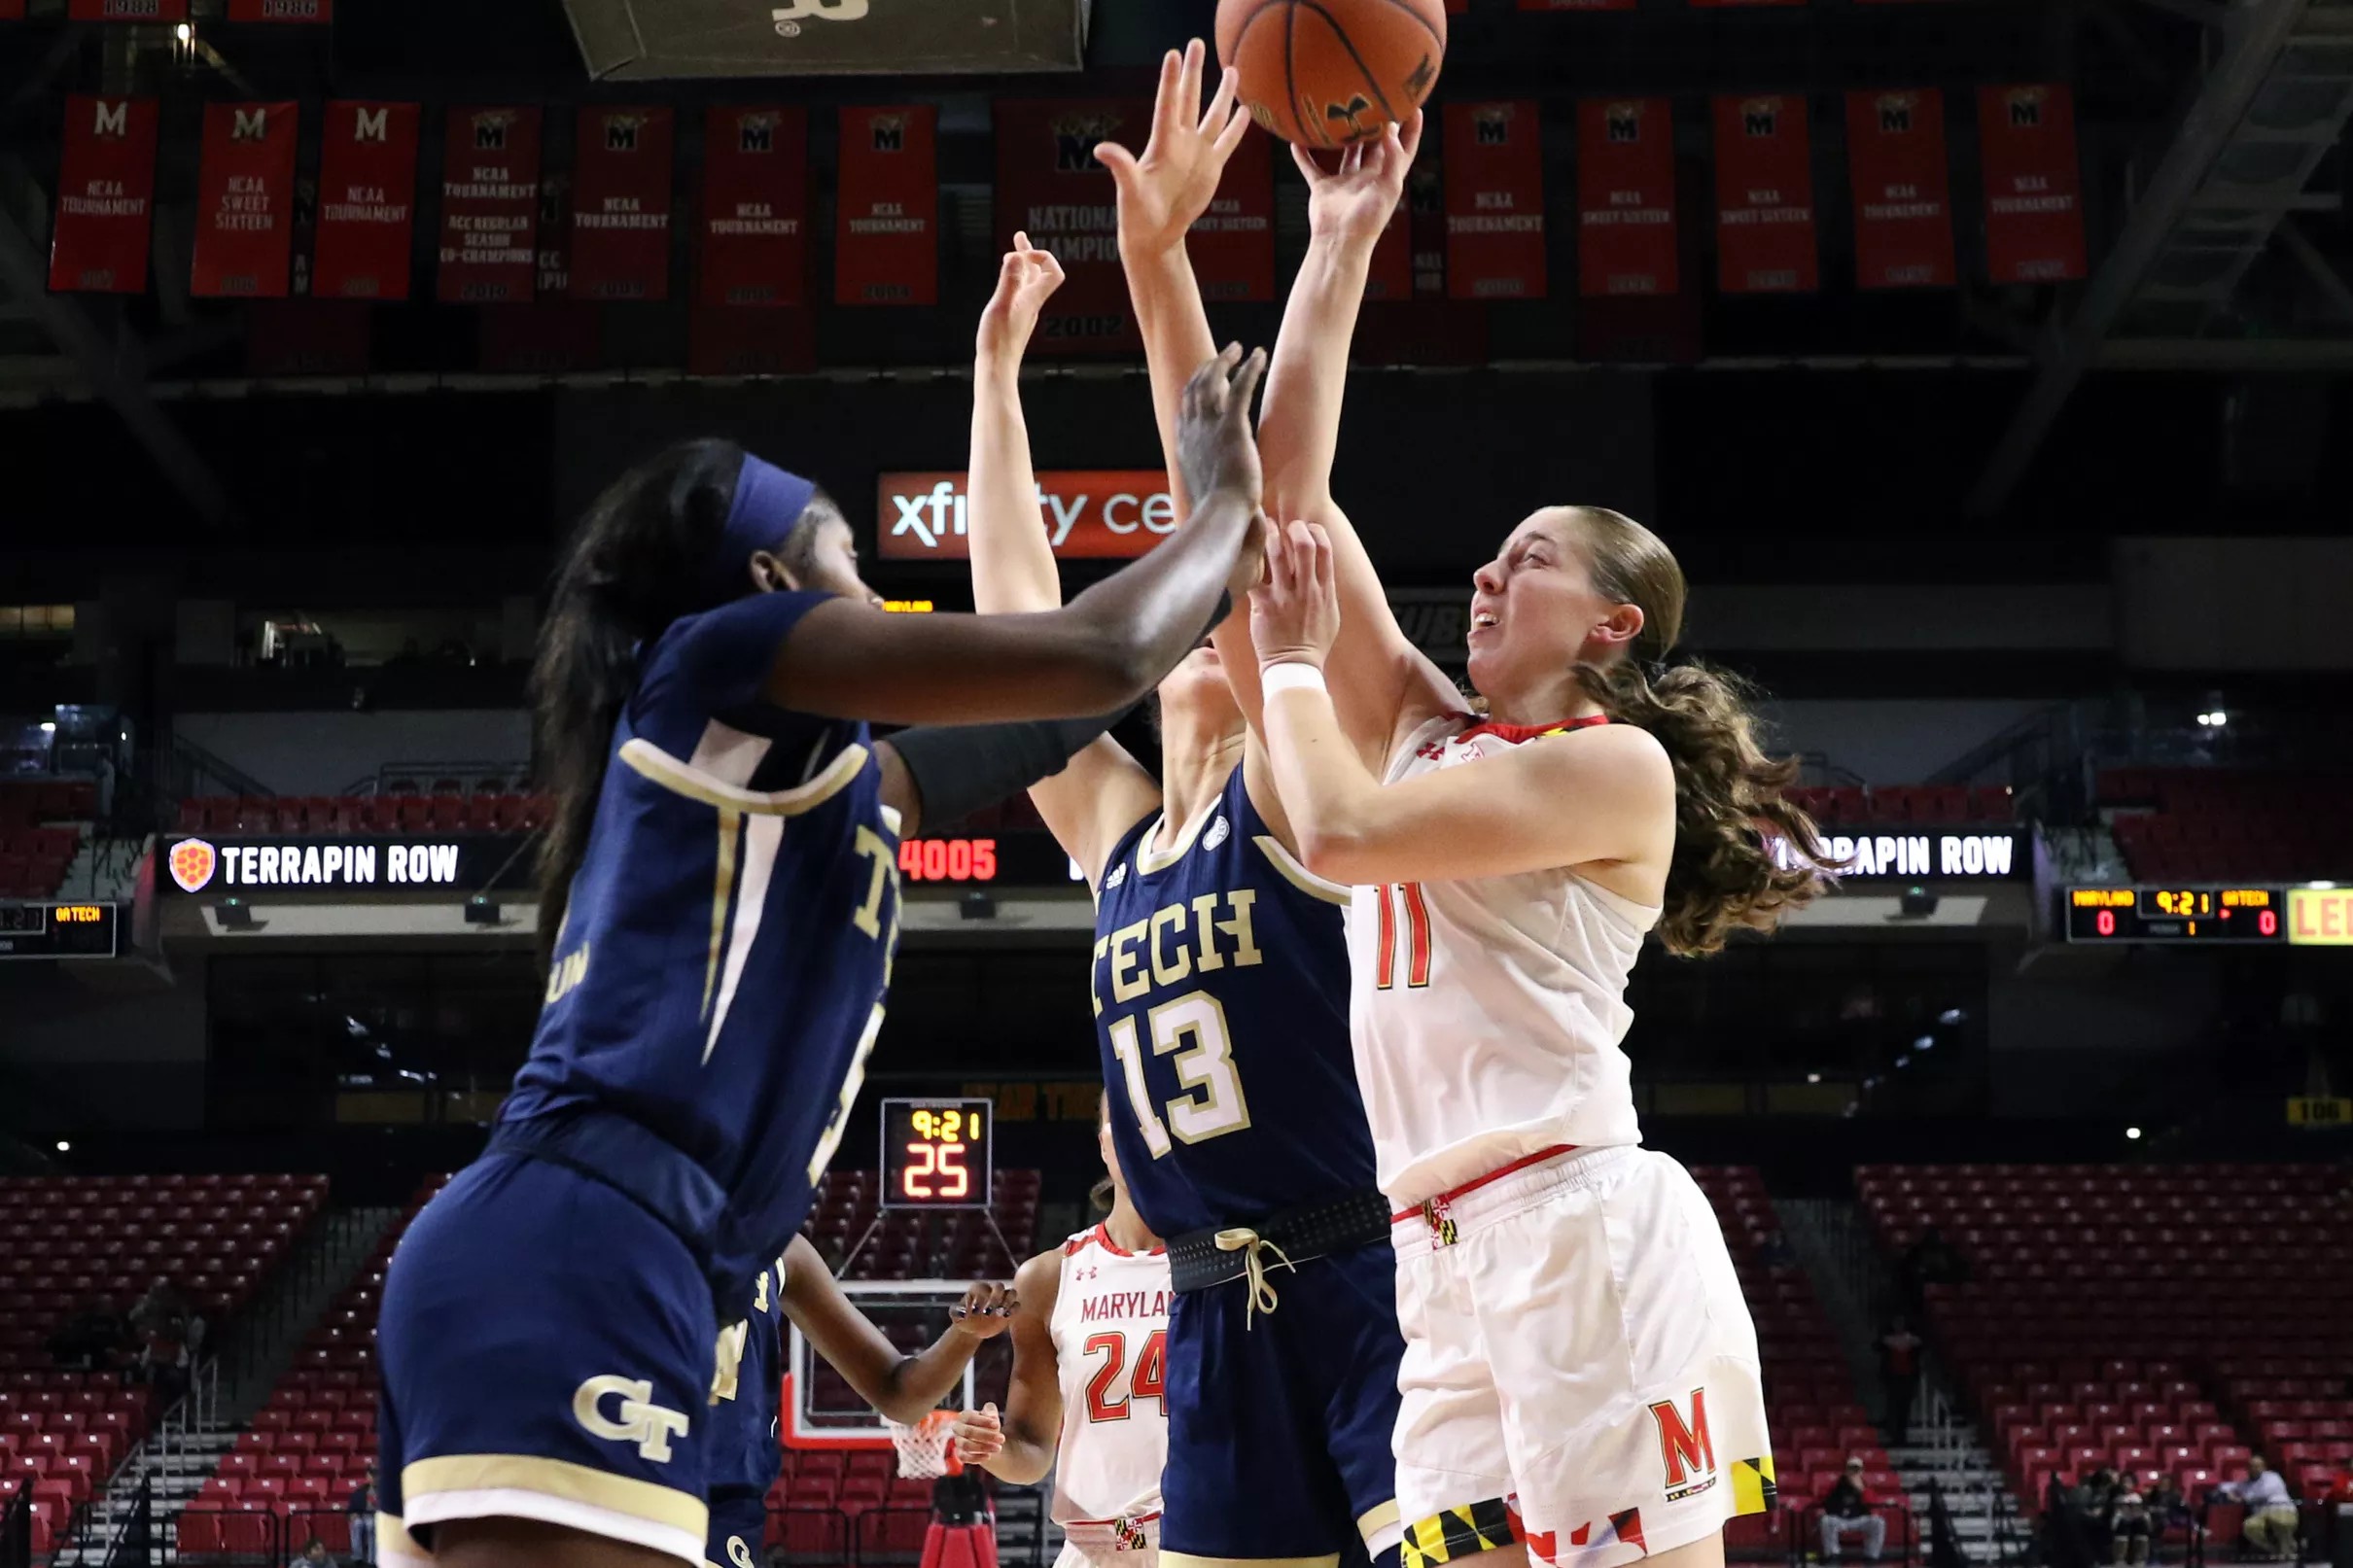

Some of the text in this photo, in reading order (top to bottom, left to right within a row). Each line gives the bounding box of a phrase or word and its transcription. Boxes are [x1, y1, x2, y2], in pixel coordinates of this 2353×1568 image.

[93, 101, 128, 136] M
[231, 108, 266, 140] M
[354, 107, 389, 143] M
[472, 166, 509, 181] NCAA
[87, 181, 123, 196] NCAA
[228, 176, 264, 192] NCAA
[443, 182, 537, 198] TOURNAMENT
[221, 195, 270, 211] SWEET
[347, 186, 385, 203] NCAA
[603, 197, 640, 212] NCAA
[1474, 192, 1513, 209] NCAA
[1991, 195, 2074, 214] TOURNAMENT
[62, 197, 146, 217] TOURNAMENT
[324, 204, 407, 224] TOURNAMENT
[736, 203, 772, 218] NCAA
[1863, 203, 1941, 220] TOURNAMENT
[215, 213, 273, 230] SIXTEEN
[575, 213, 669, 229] TOURNAMENT
[710, 219, 798, 235] TOURNAMENT
[849, 219, 926, 233] TOURNAMENT
[1028, 205, 1117, 231] NATIONA
[1447, 214, 1544, 233] TOURNAMENT
[439, 248, 534, 264] CO-CHAMPIONS
[1044, 316, 1123, 337] 2002
[892, 482, 1088, 547] xfiy
[222, 845, 459, 885] TERRAPIN ROW
[898, 839, 996, 881] 4005
[1941, 836, 2013, 875] ROW
[2156, 890, 2209, 916] 9:21
[2097, 910, 2115, 936] 0
[2259, 910, 2276, 935] 0
[1374, 881, 1433, 991] 11
[1107, 989, 1251, 1161] 13
[912, 1110, 980, 1142] 9:21
[904, 1143, 967, 1197] 25
[1083, 1329, 1170, 1424] 24
[573, 1374, 689, 1464] GT
[1648, 1386, 1716, 1489] M
